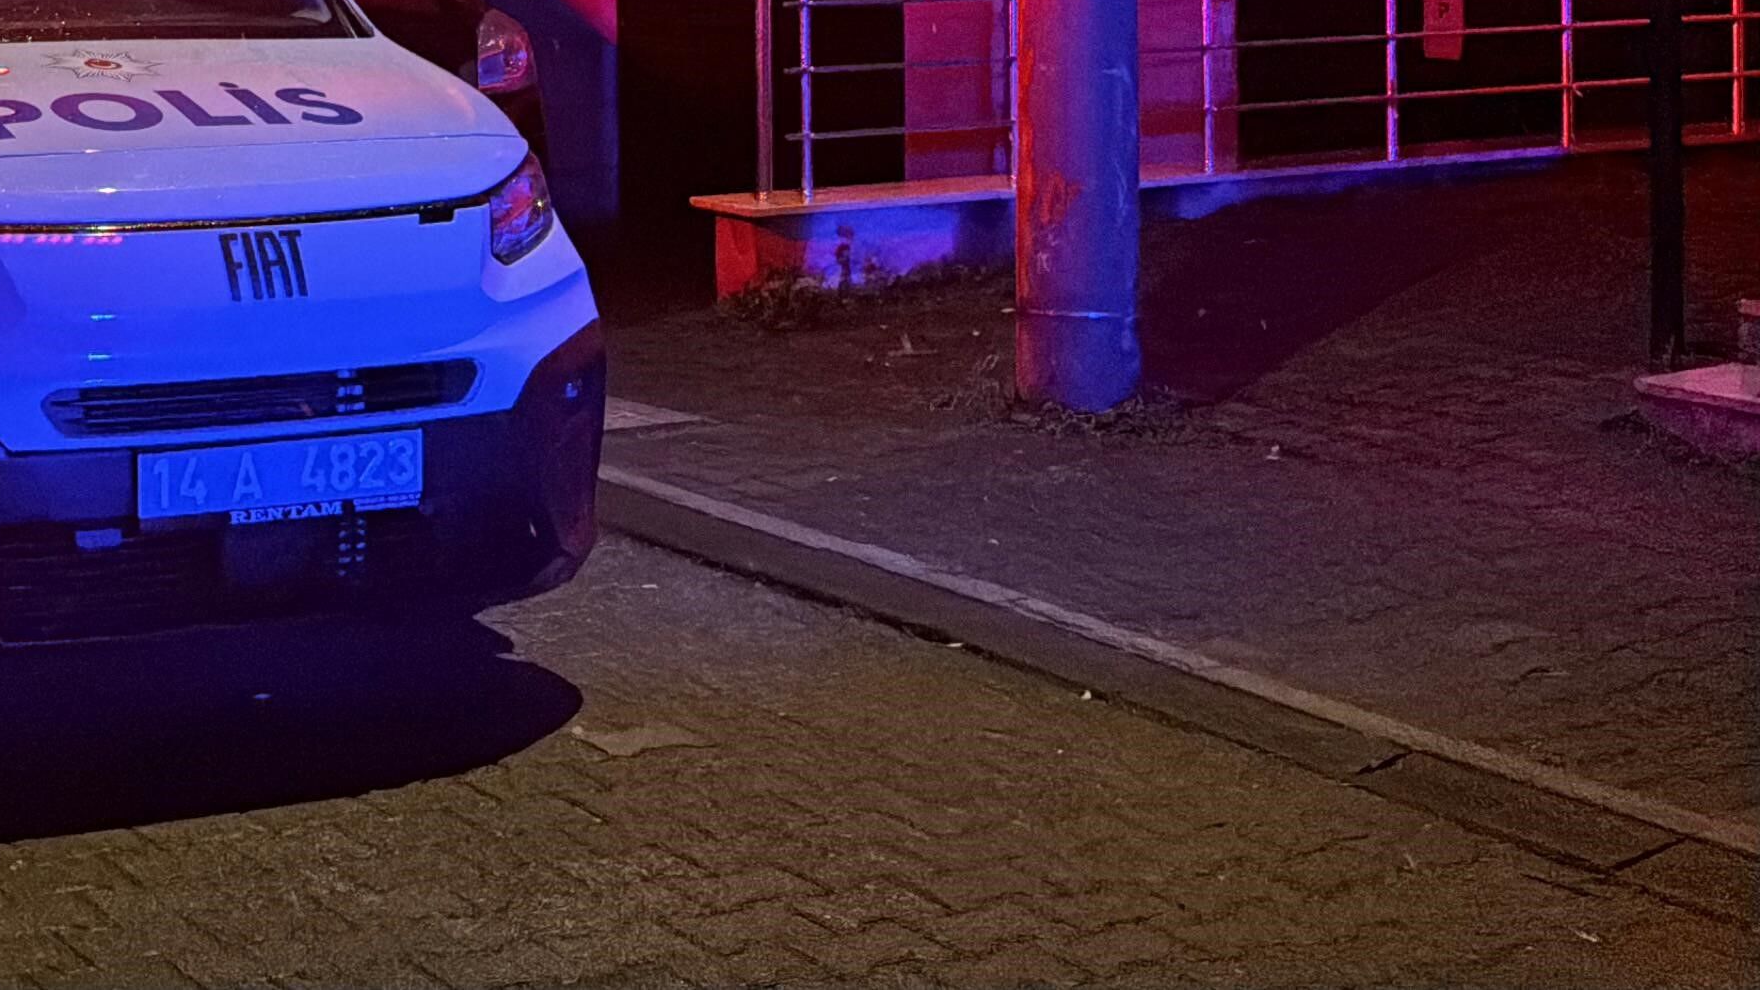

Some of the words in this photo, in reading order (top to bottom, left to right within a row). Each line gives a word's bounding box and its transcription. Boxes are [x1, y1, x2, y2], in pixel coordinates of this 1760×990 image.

[219, 229, 308, 302] FIAT
[152, 455, 209, 509] 14
[232, 451, 263, 502] A
[300, 436, 416, 494] 4823
[229, 501, 343, 525] RENTAM
